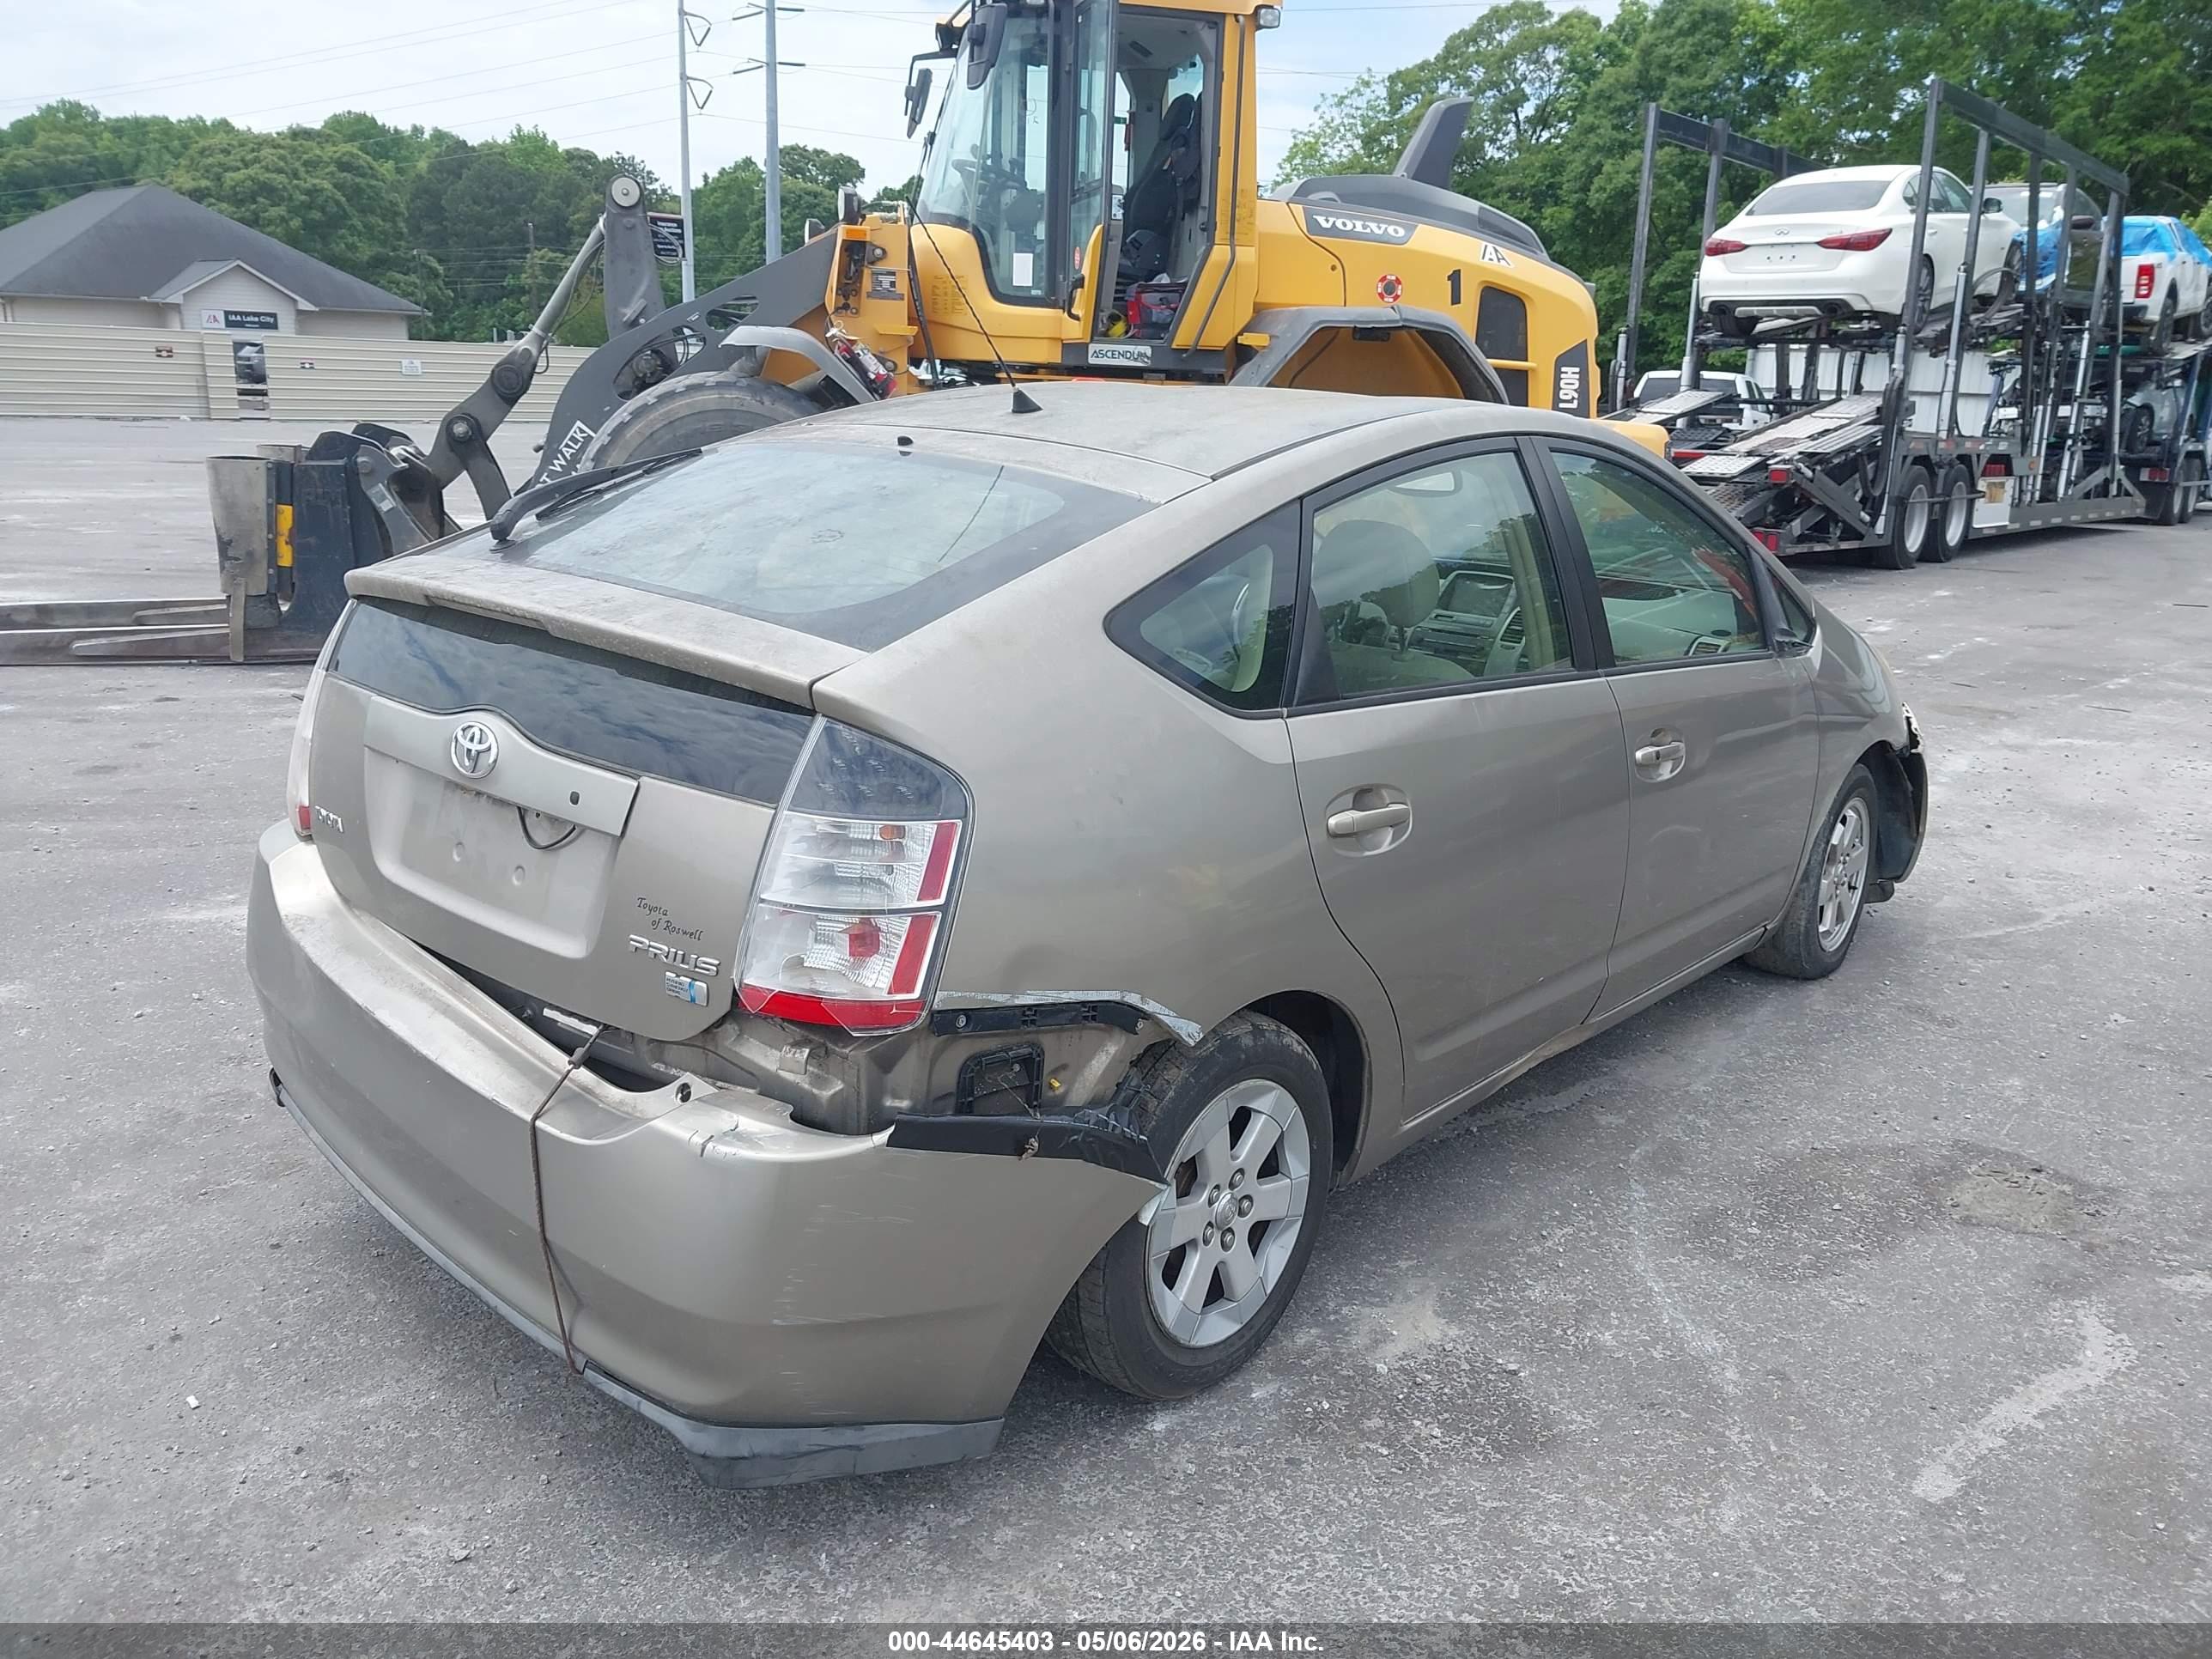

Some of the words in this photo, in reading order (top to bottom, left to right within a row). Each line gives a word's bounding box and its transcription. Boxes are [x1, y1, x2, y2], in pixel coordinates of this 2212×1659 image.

[1312, 215, 1406, 237] VOLVO
[1447, 269, 1462, 306] 1
[259, 315, 275, 324] City
[1559, 367, 1580, 409] L90H
[548, 428, 589, 473] WALK
[637, 897, 668, 916] Toyota
[651, 918, 662, 930] of
[663, 920, 703, 941] Roswell
[629, 934, 721, 977] PRIUS
